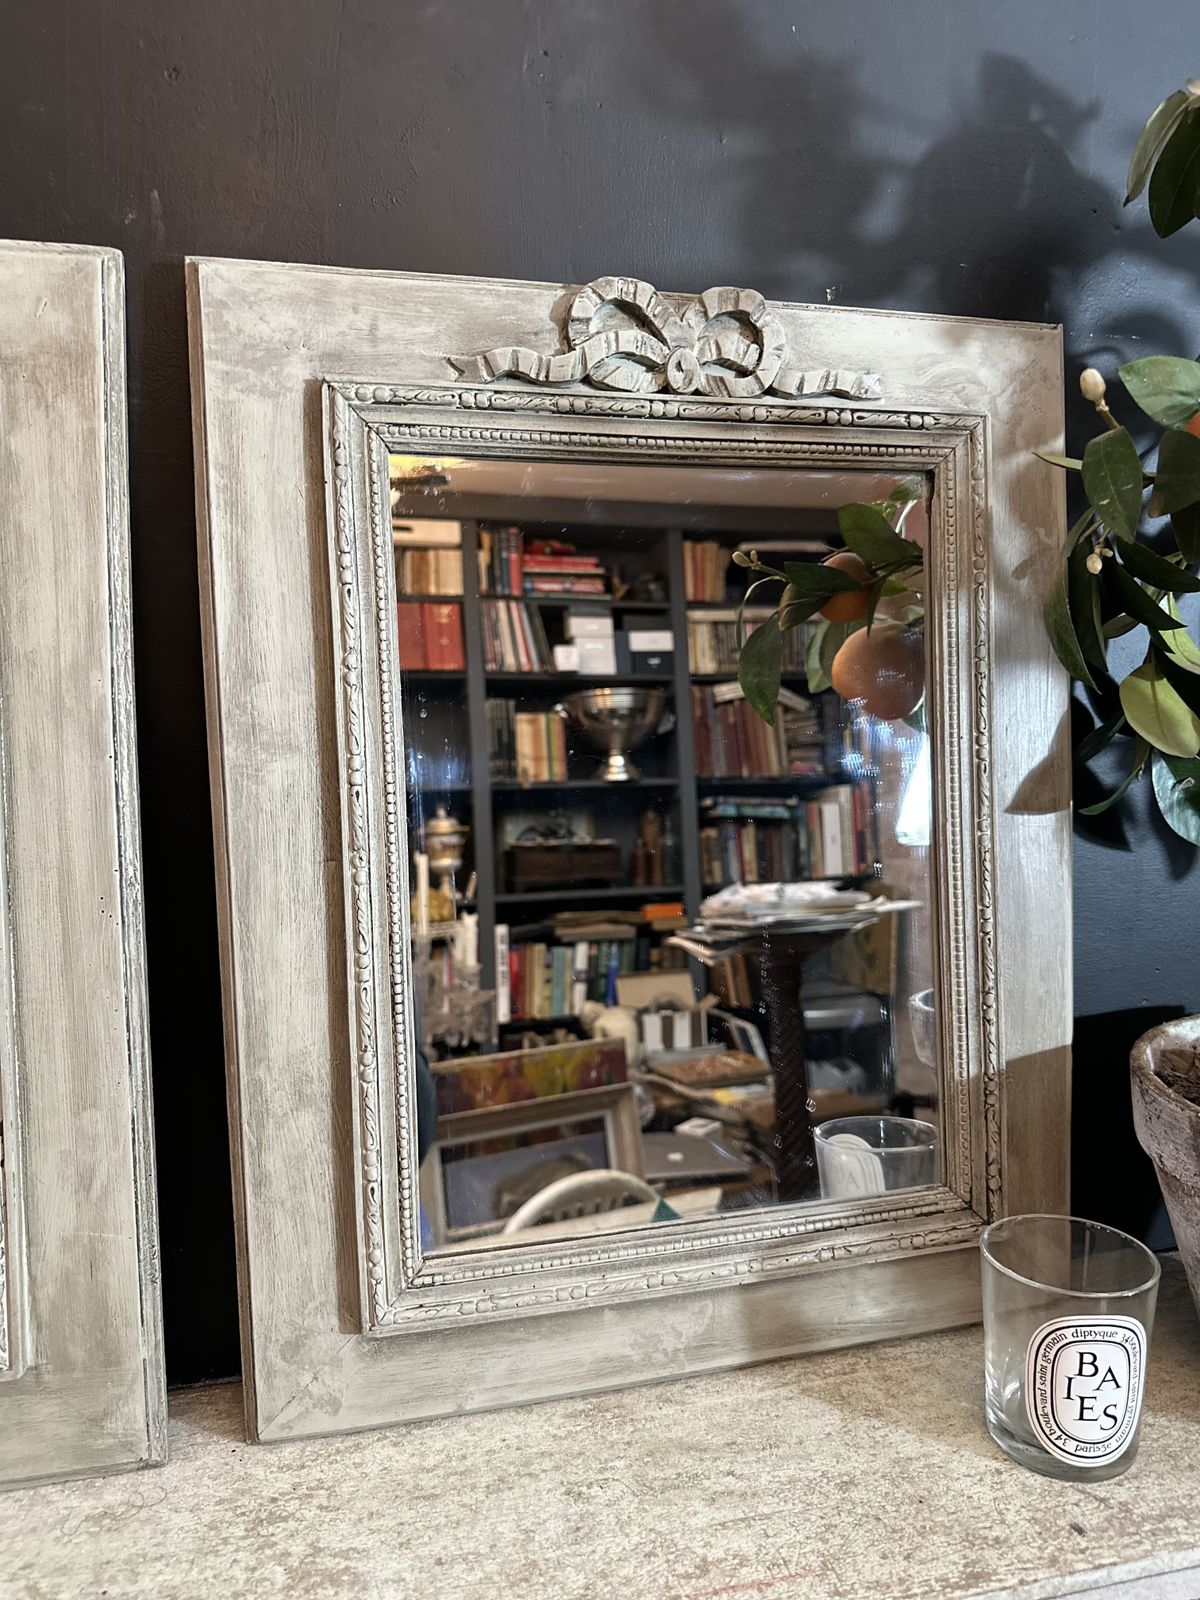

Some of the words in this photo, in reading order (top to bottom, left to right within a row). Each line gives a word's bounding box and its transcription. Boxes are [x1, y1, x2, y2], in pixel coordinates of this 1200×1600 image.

[1071, 1328, 1118, 1340] diptyque
[1041, 1332, 1067, 1365] germain
[1120, 1333, 1131, 1344] 34
[1128, 1335, 1138, 1380] boulevard
[1037, 1364, 1048, 1388] saint
[1037, 1387, 1057, 1436] boulevard
[1054, 1433, 1071, 1447] 34
